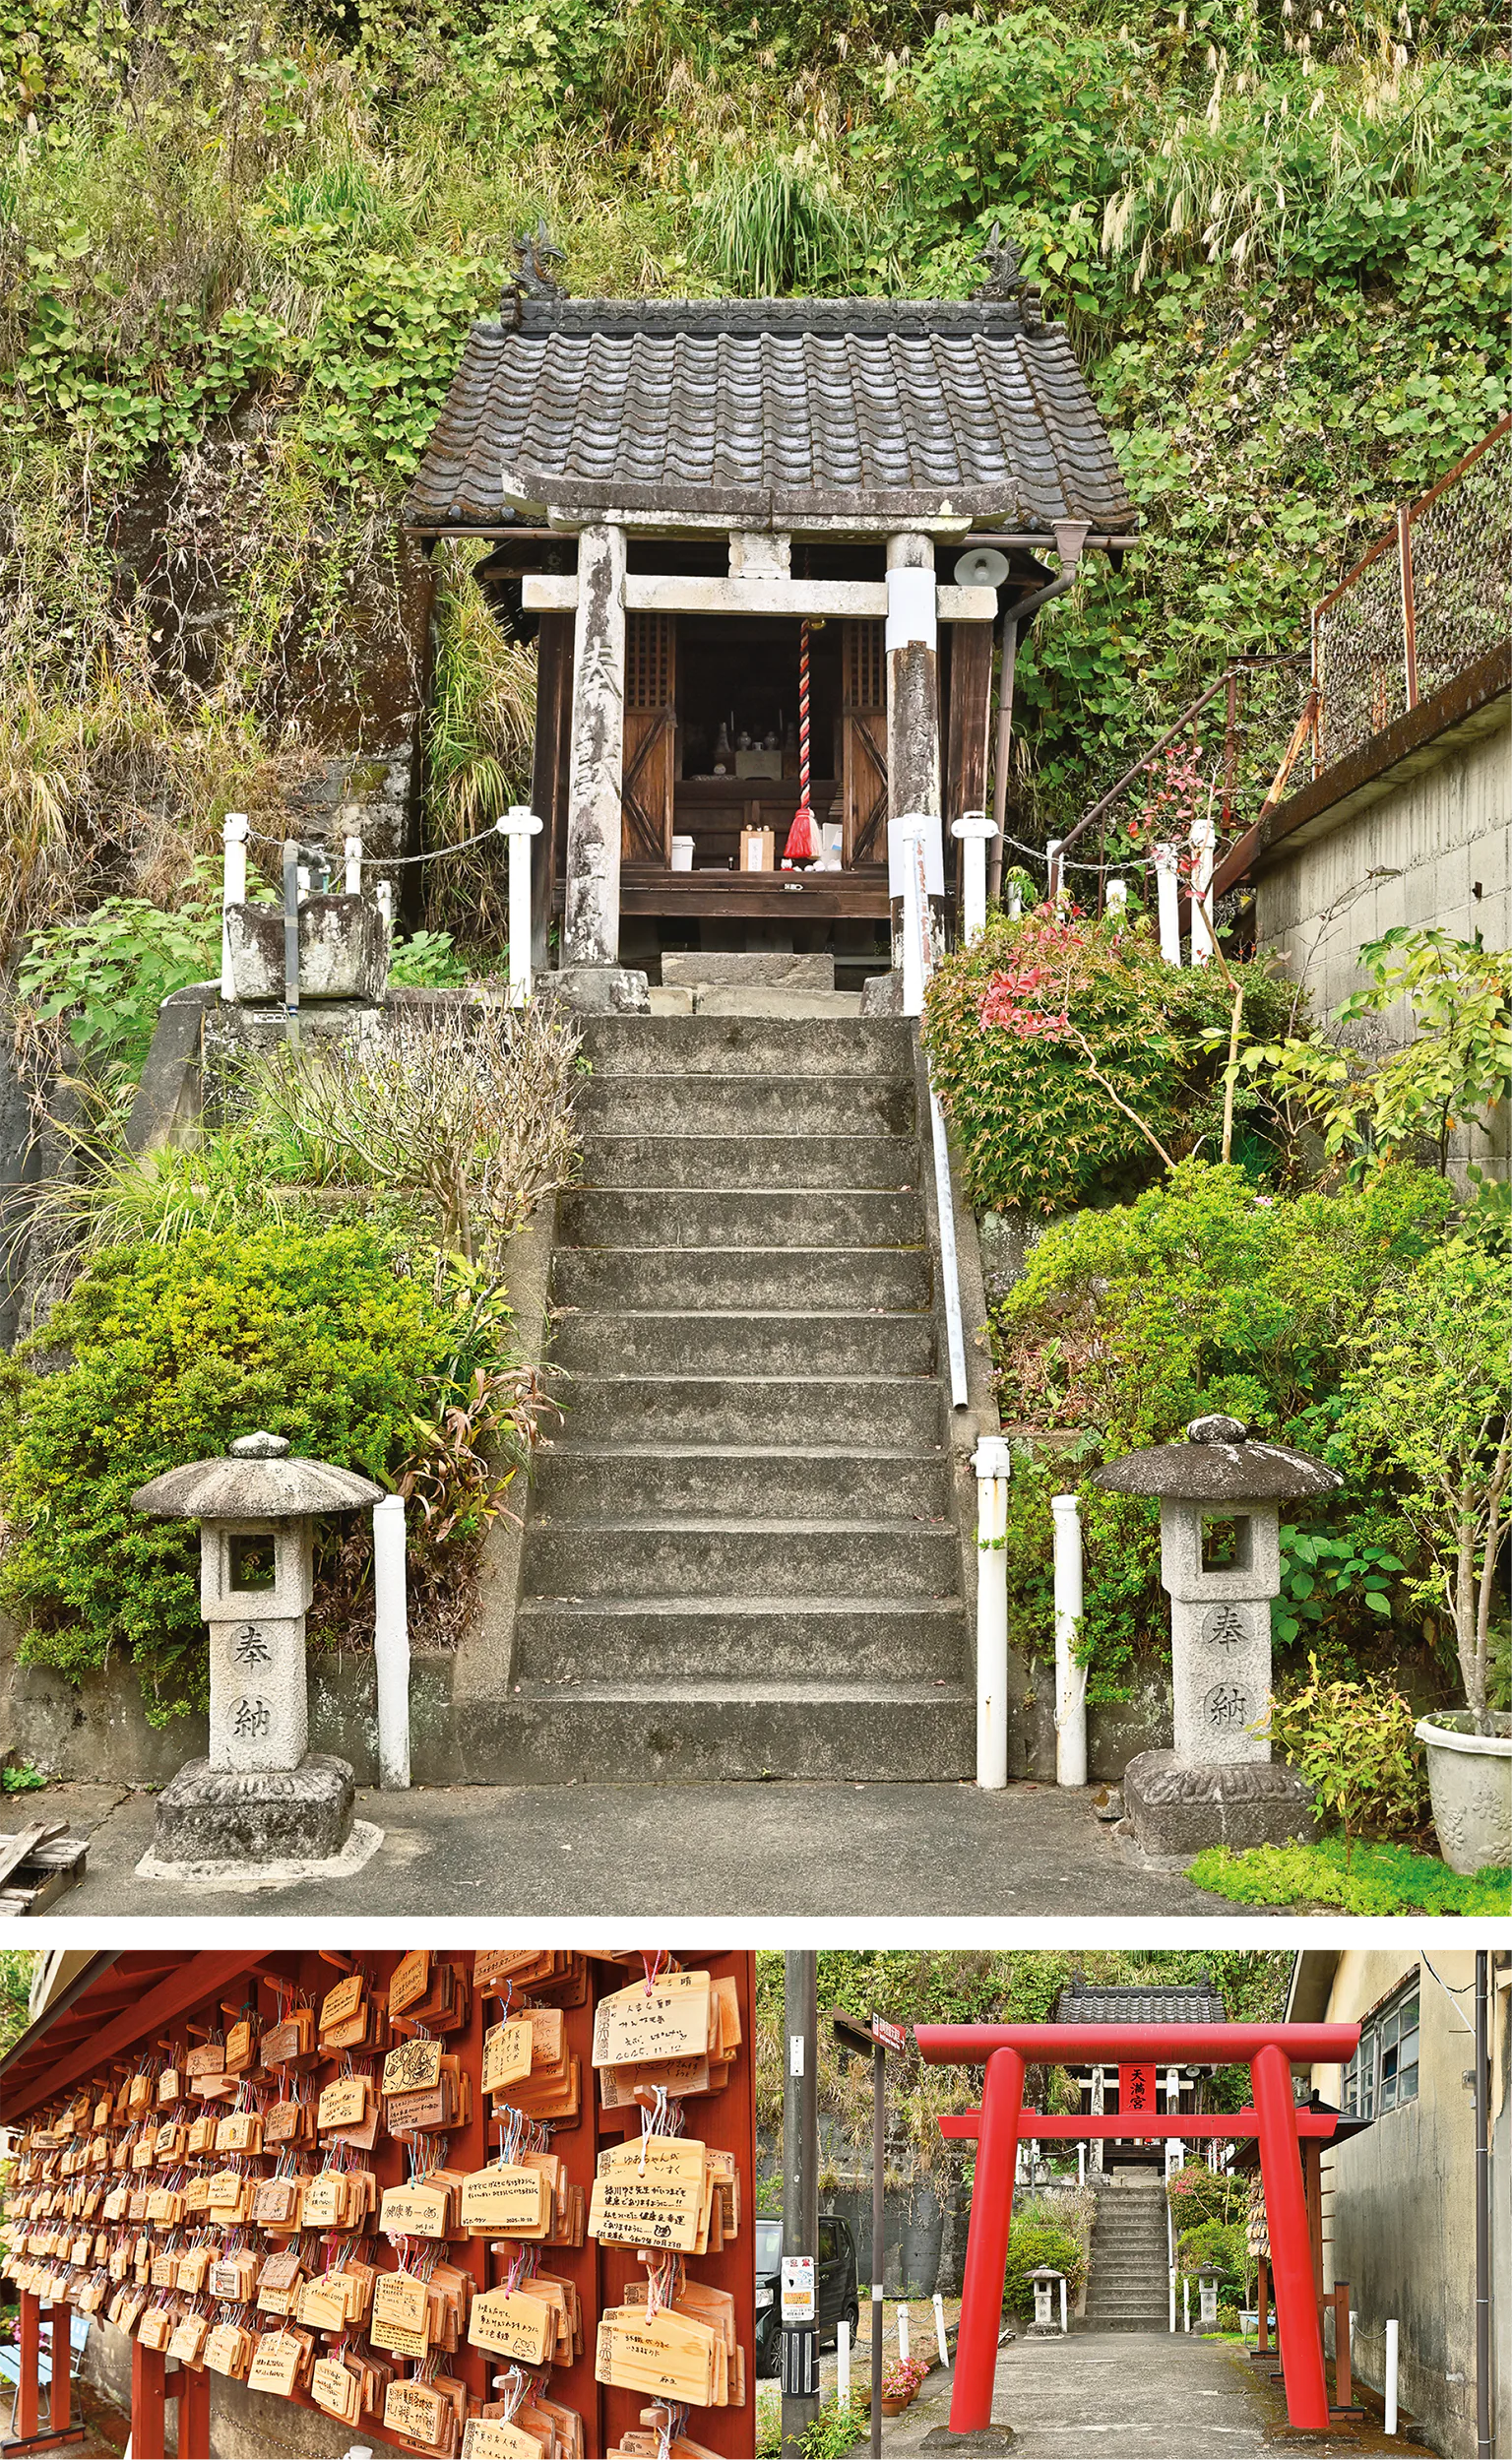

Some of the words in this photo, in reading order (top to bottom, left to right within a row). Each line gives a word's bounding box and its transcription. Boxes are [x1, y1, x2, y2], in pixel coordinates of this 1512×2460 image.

[232, 1626, 273, 1738] 奉納
[1207, 1606, 1249, 1727] 奉納
[1130, 2068, 1146, 2110] 天満宮
